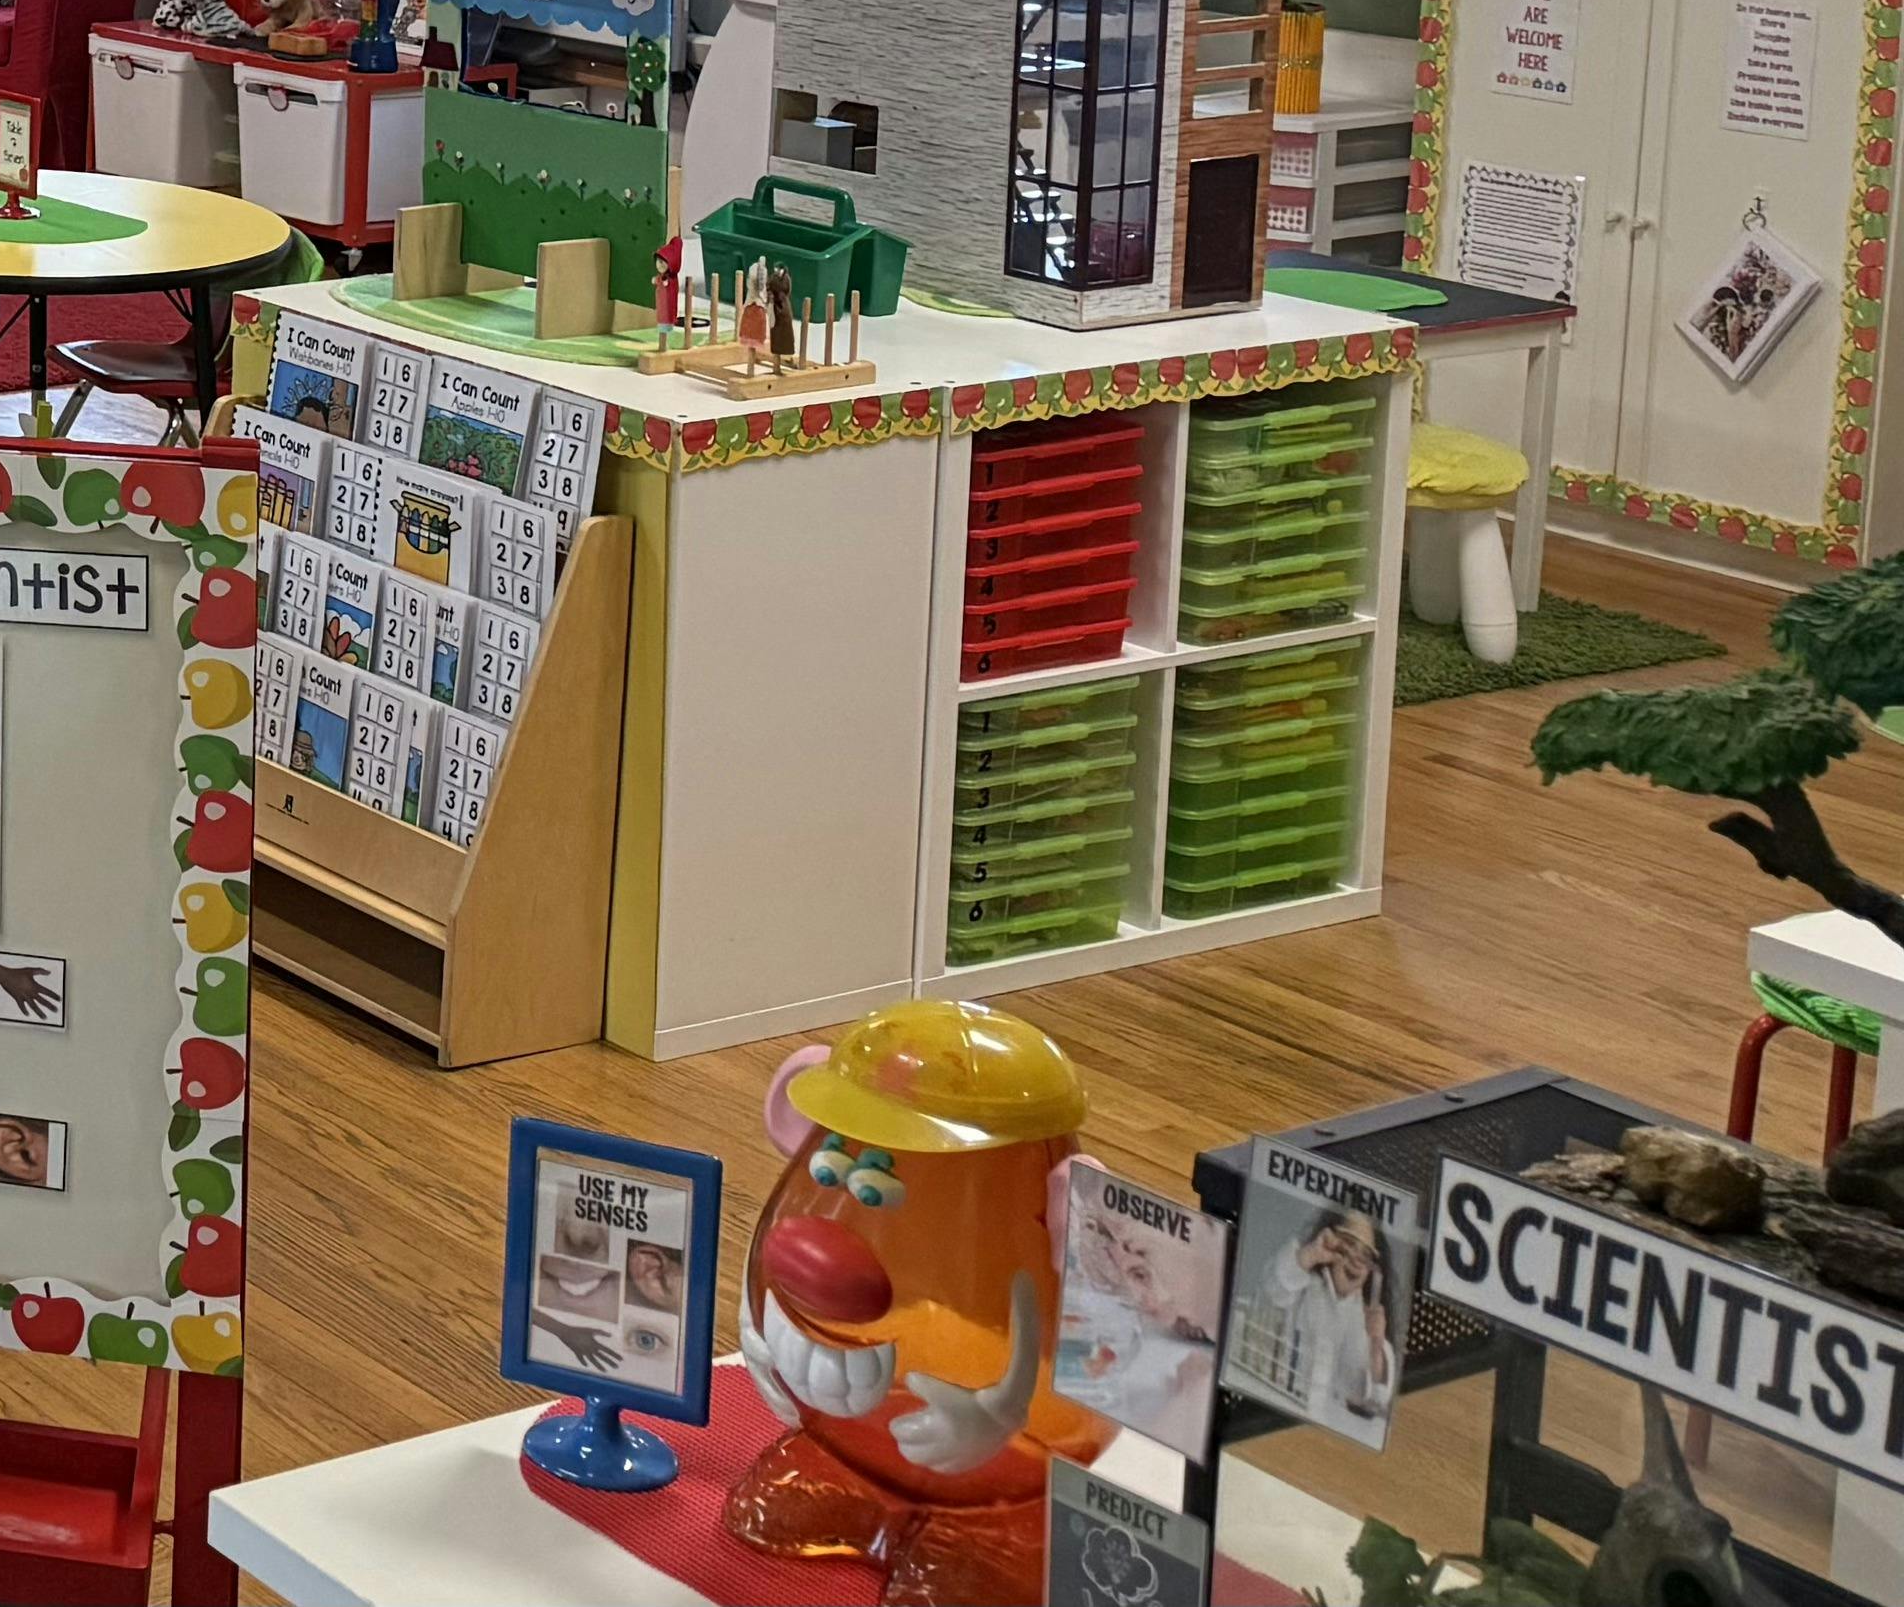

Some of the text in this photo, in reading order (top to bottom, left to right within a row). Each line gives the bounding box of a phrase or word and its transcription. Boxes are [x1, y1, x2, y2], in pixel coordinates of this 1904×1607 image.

[1523, 6, 1549, 24] ARE
[1506, 26, 1563, 51] WELCOME
[1518, 52, 1549, 72] HERE
[287, 327, 356, 363] I Can Count
[440, 372, 521, 412] I Can Count
[451, 396, 483, 418] Apples
[579, 1174, 649, 1208] USE MY
[1267, 1149, 1400, 1226] EXPERIMENT
[574, 1196, 649, 1233] SENSES
[1102, 1183, 1192, 1243] OBSERVE
[1084, 1481, 1169, 1542] PREDICT
